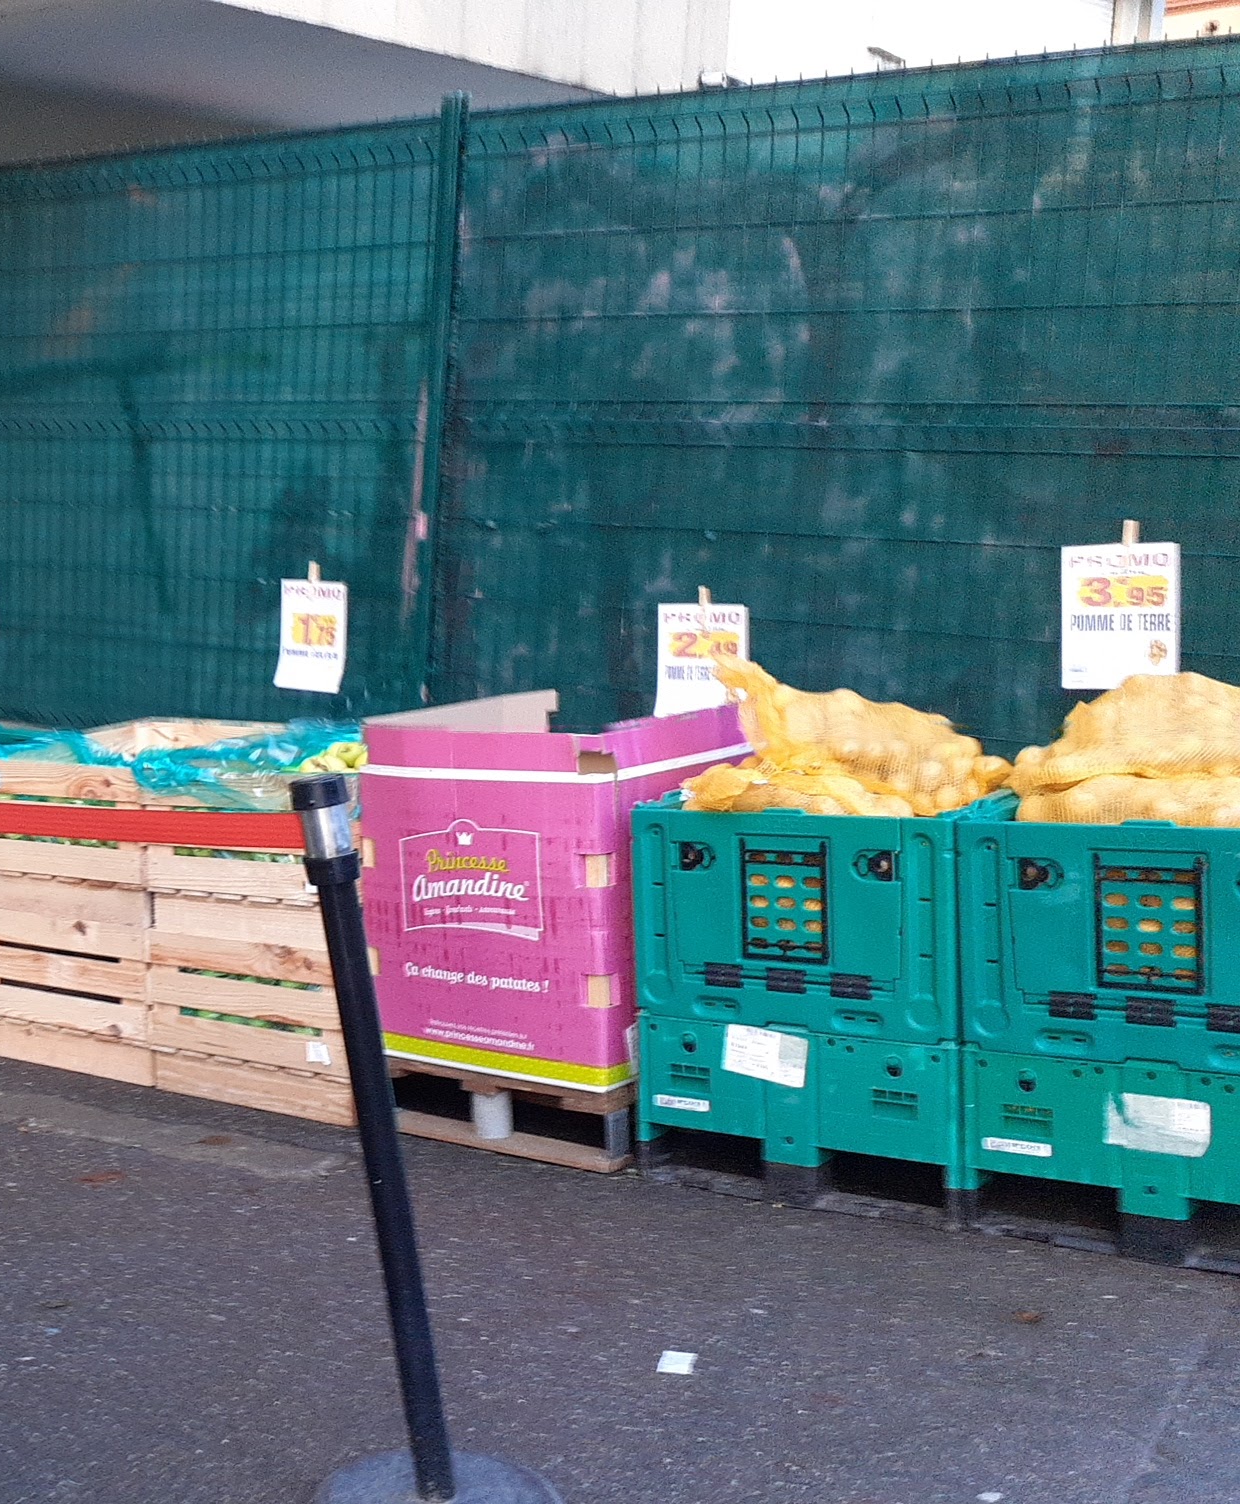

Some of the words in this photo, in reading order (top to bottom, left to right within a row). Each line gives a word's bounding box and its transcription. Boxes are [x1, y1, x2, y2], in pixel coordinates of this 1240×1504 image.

[1069, 552, 1171, 568] PROMO
[1070, 613, 1114, 631] POMME
[1119, 613, 1133, 631] DE
[1137, 612, 1171, 631] TERRE
[425, 848, 511, 873] Princesse
[412, 871, 530, 902] Amandine
[404, 962, 420, 977] Ça
[420, 965, 465, 984] change
[466, 971, 489, 986] des
[490, 976, 541, 992] patates
